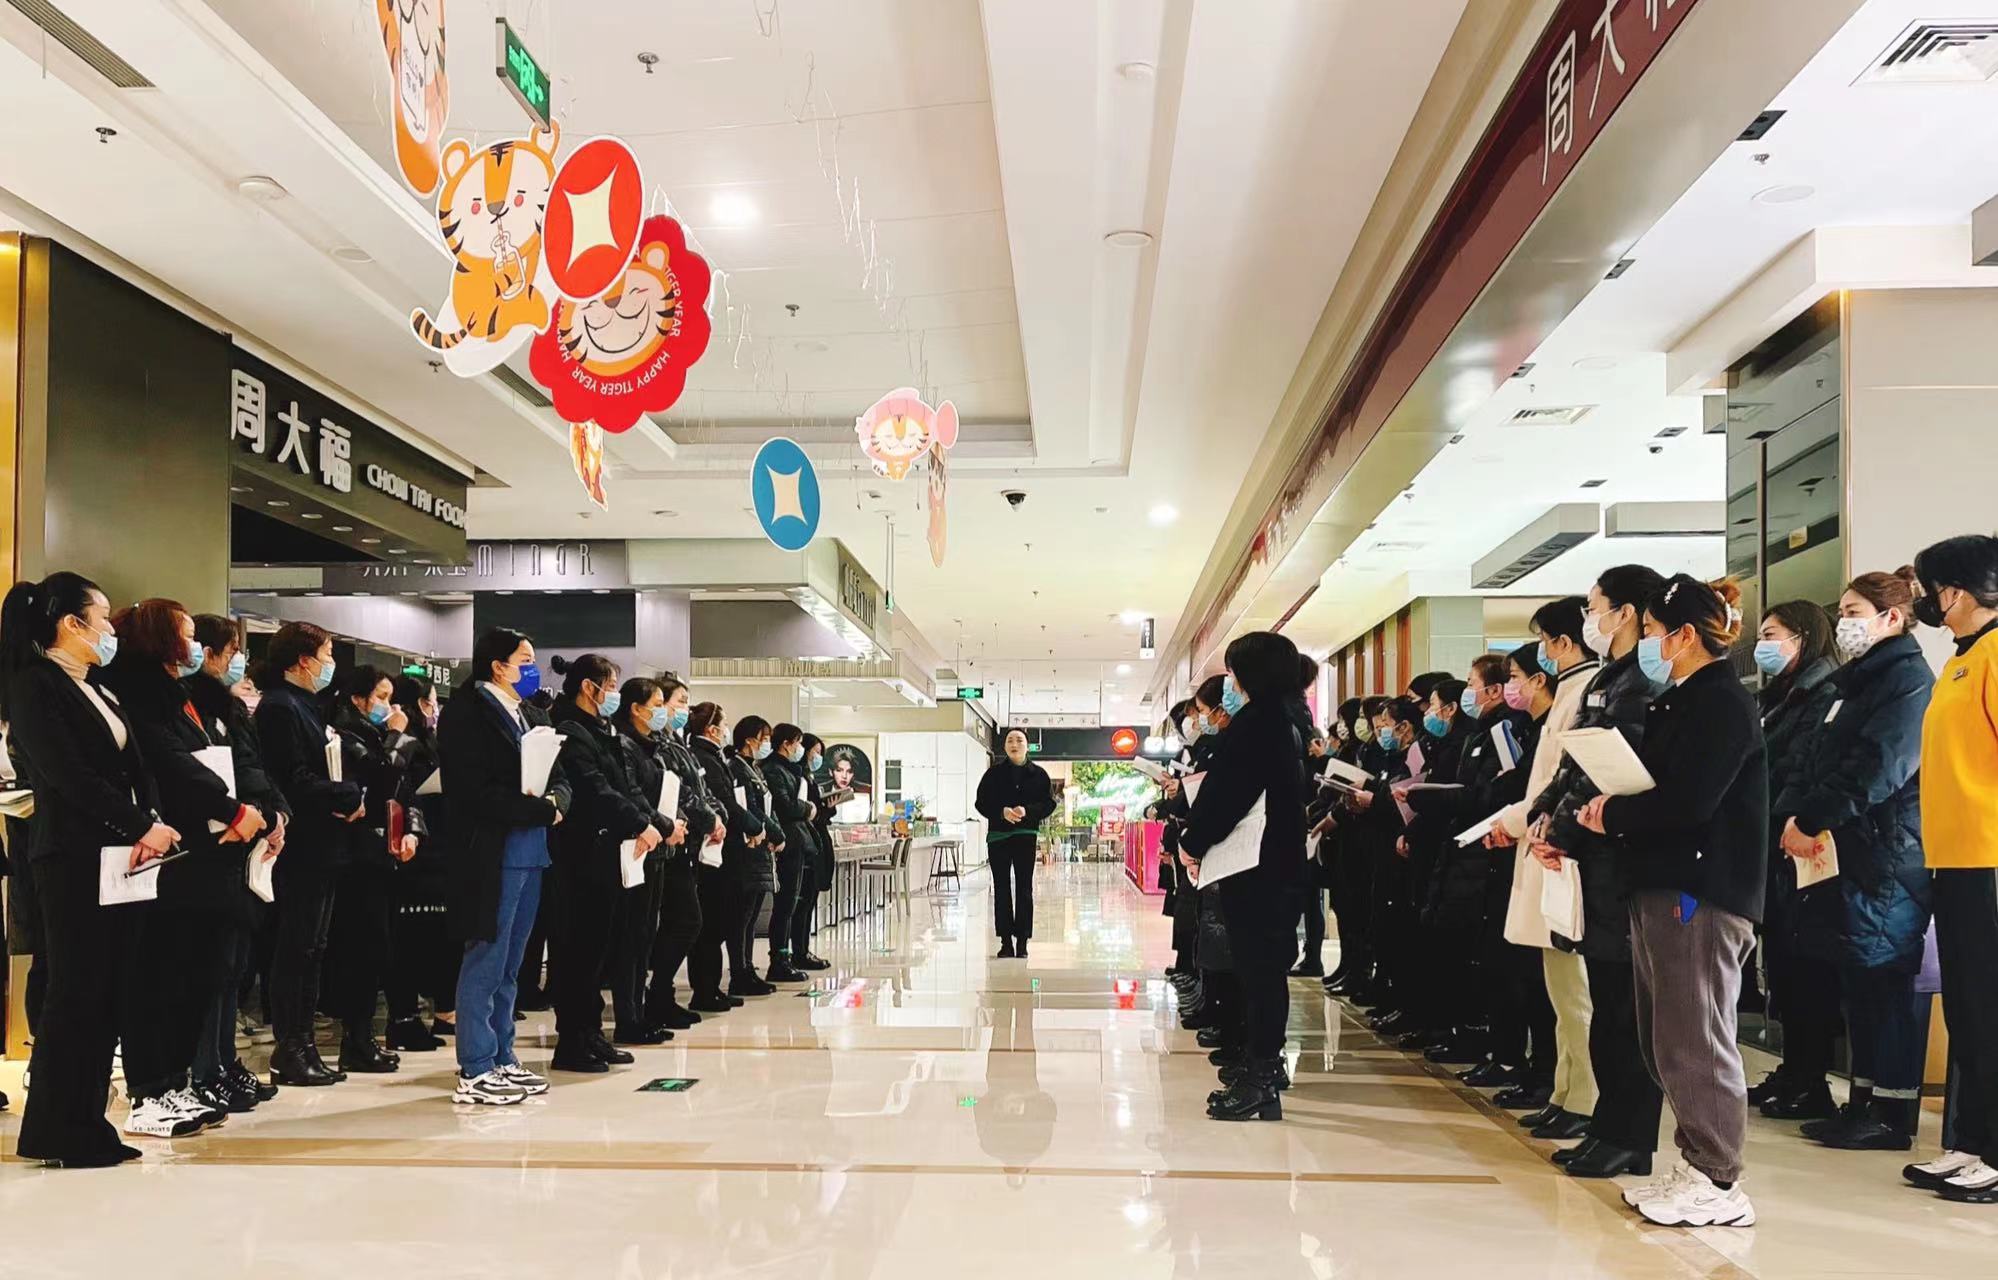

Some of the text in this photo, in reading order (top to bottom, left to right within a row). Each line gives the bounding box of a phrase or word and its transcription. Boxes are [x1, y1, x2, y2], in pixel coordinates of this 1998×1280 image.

[571, 351, 671, 395] HAPPY TIGER YEAR
[231, 368, 351, 492] 周大福
[366, 463, 408, 500] CHOW
[410, 484, 432, 512] TAI
